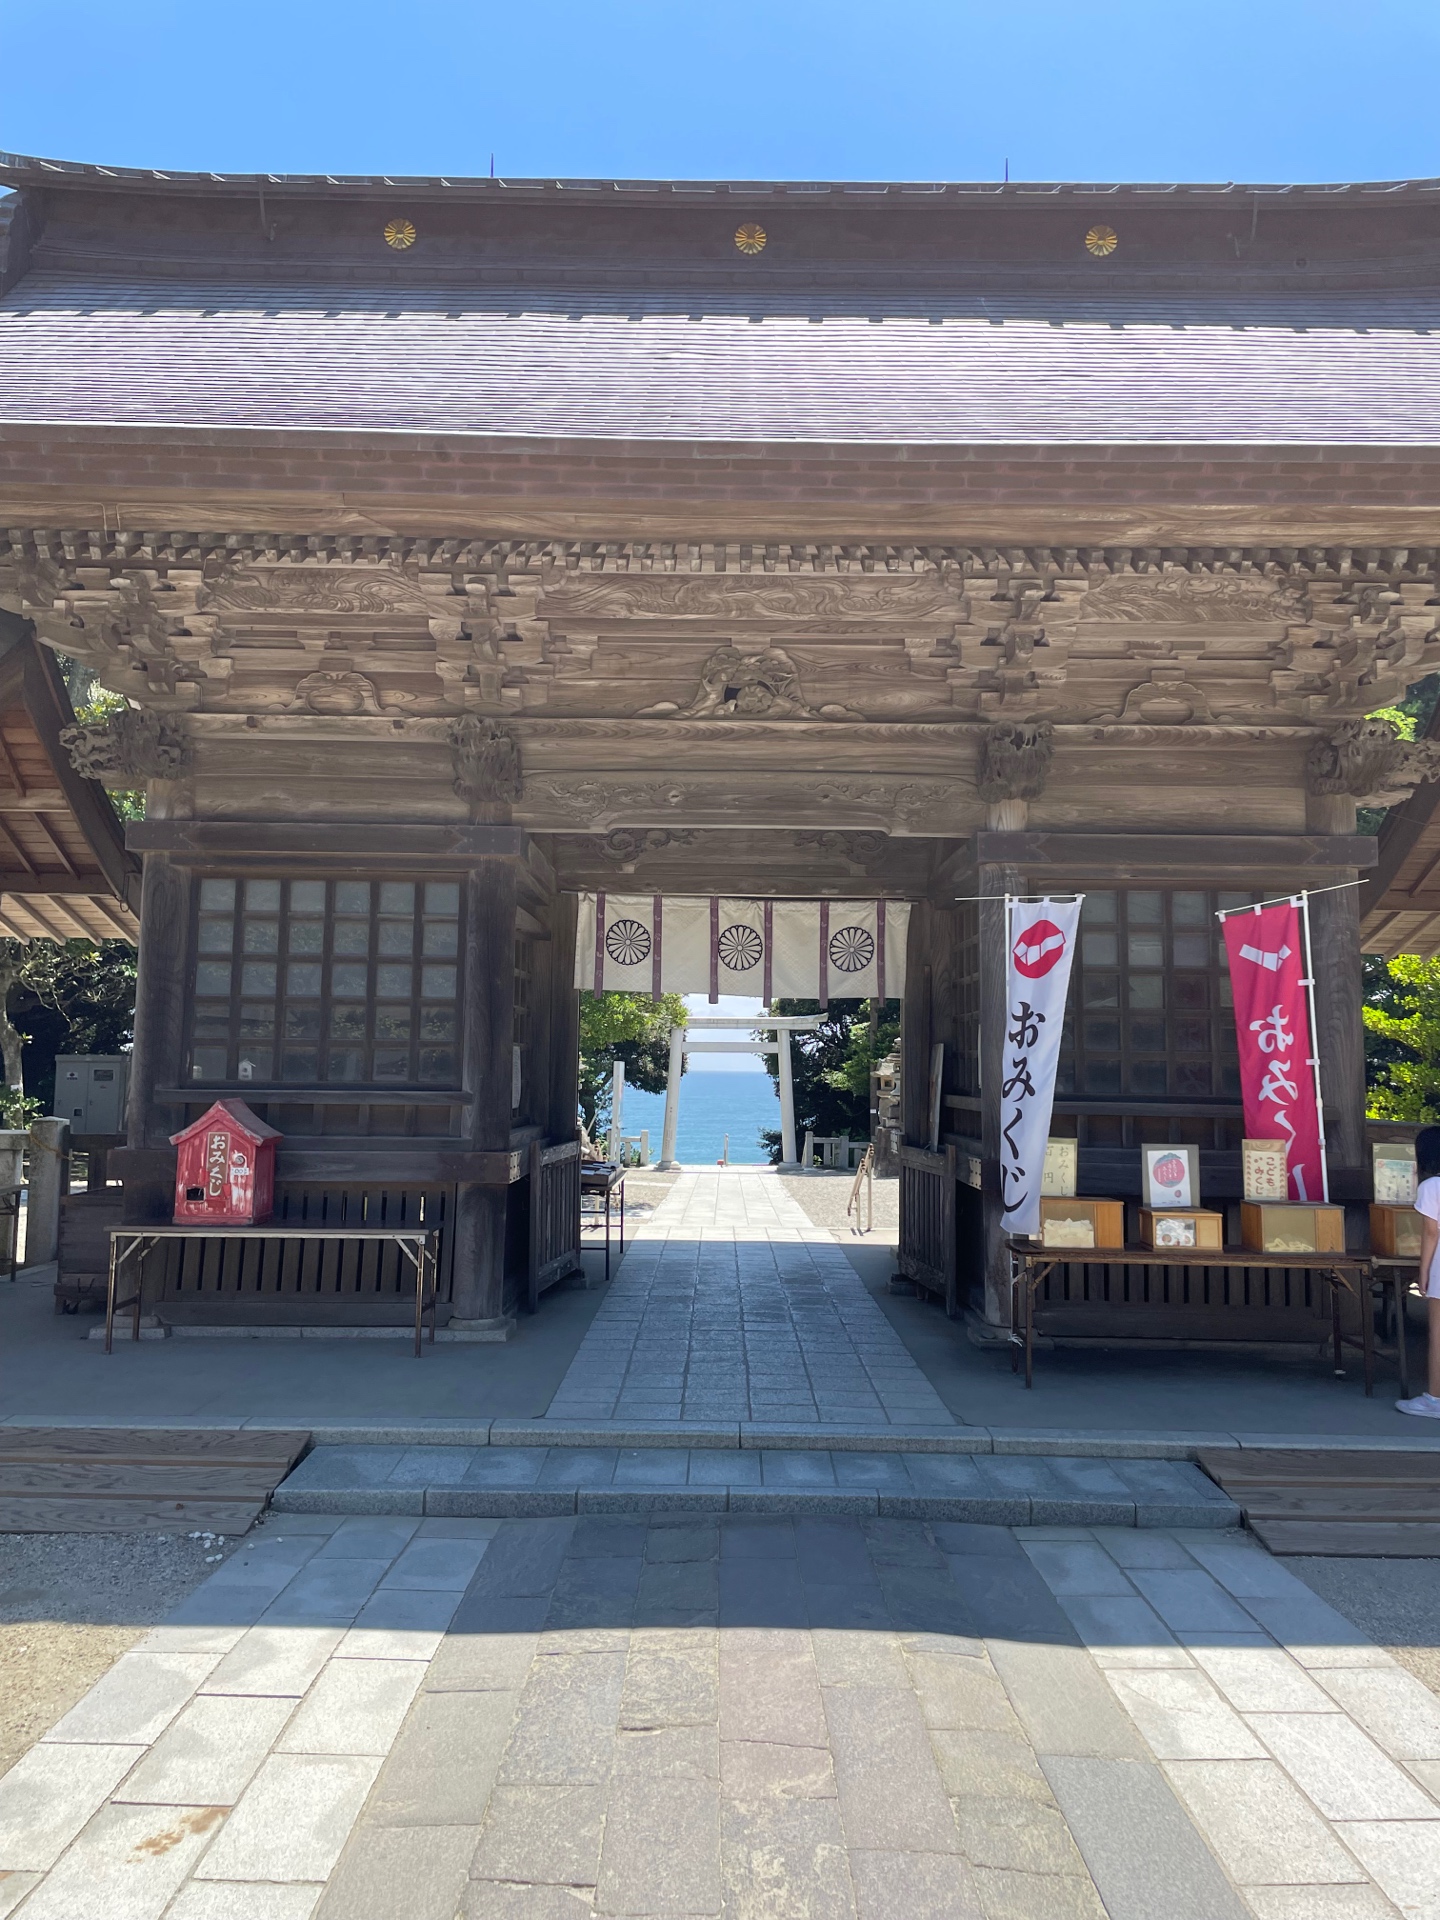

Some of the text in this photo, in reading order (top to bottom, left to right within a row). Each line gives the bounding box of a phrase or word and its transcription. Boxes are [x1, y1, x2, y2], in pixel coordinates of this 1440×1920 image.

[1002, 1001, 1046, 1213] おみくじ
[210, 1135, 225, 1196] おみくじ
[1059, 1146, 1069, 1196] おみくじ
[1266, 1156, 1276, 1187] こども
